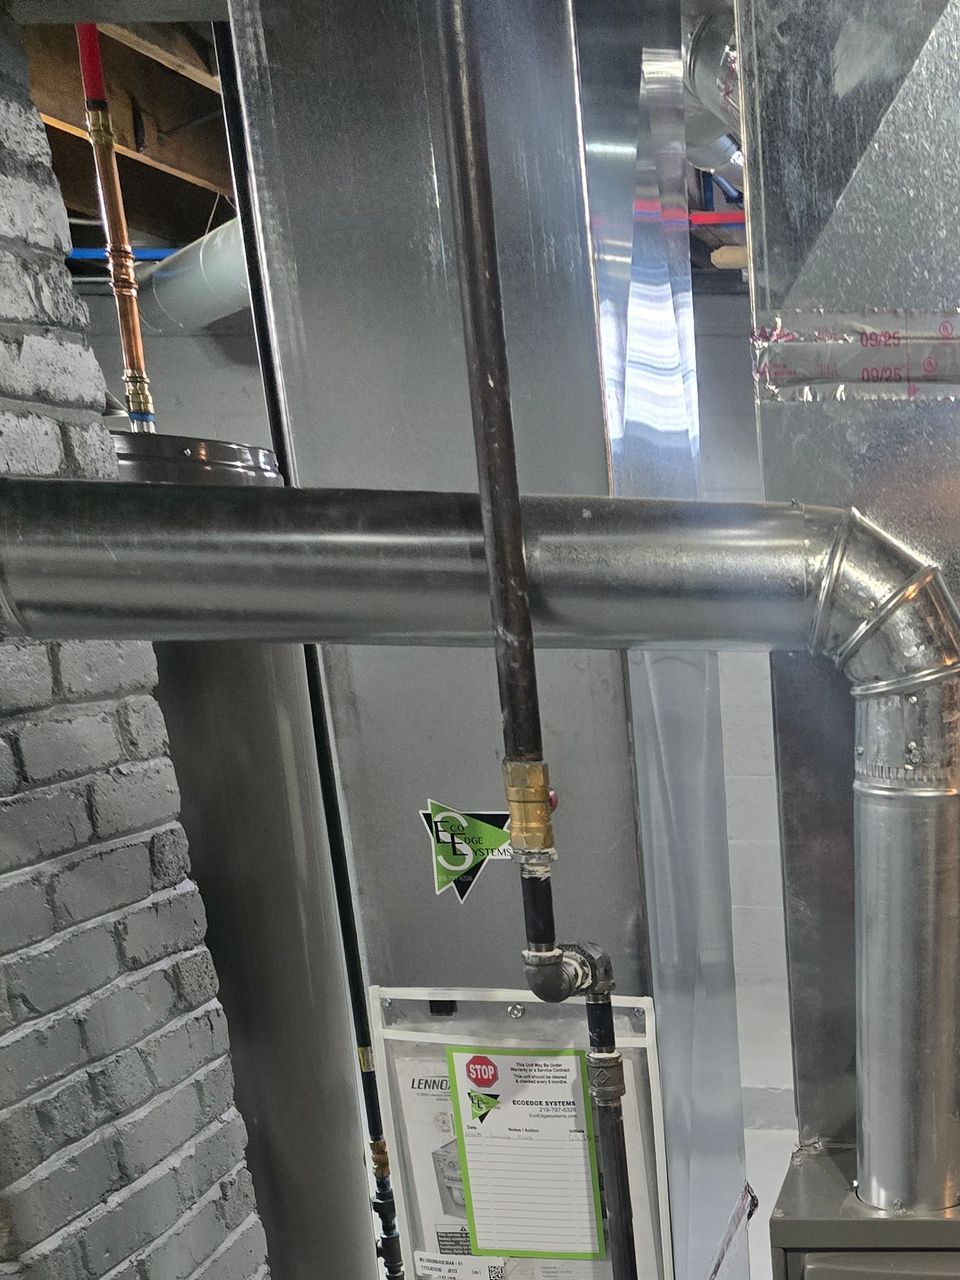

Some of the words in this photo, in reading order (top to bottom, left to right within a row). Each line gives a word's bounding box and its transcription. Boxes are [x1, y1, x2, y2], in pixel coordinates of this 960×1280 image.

[860, 331, 901, 348] 09/25
[861, 368, 901, 384] 09/25
[469, 1064, 495, 1080] STOP
[411, 1078, 451, 1091] LENNO
[512, 1099, 543, 1107] ECOEDGE
